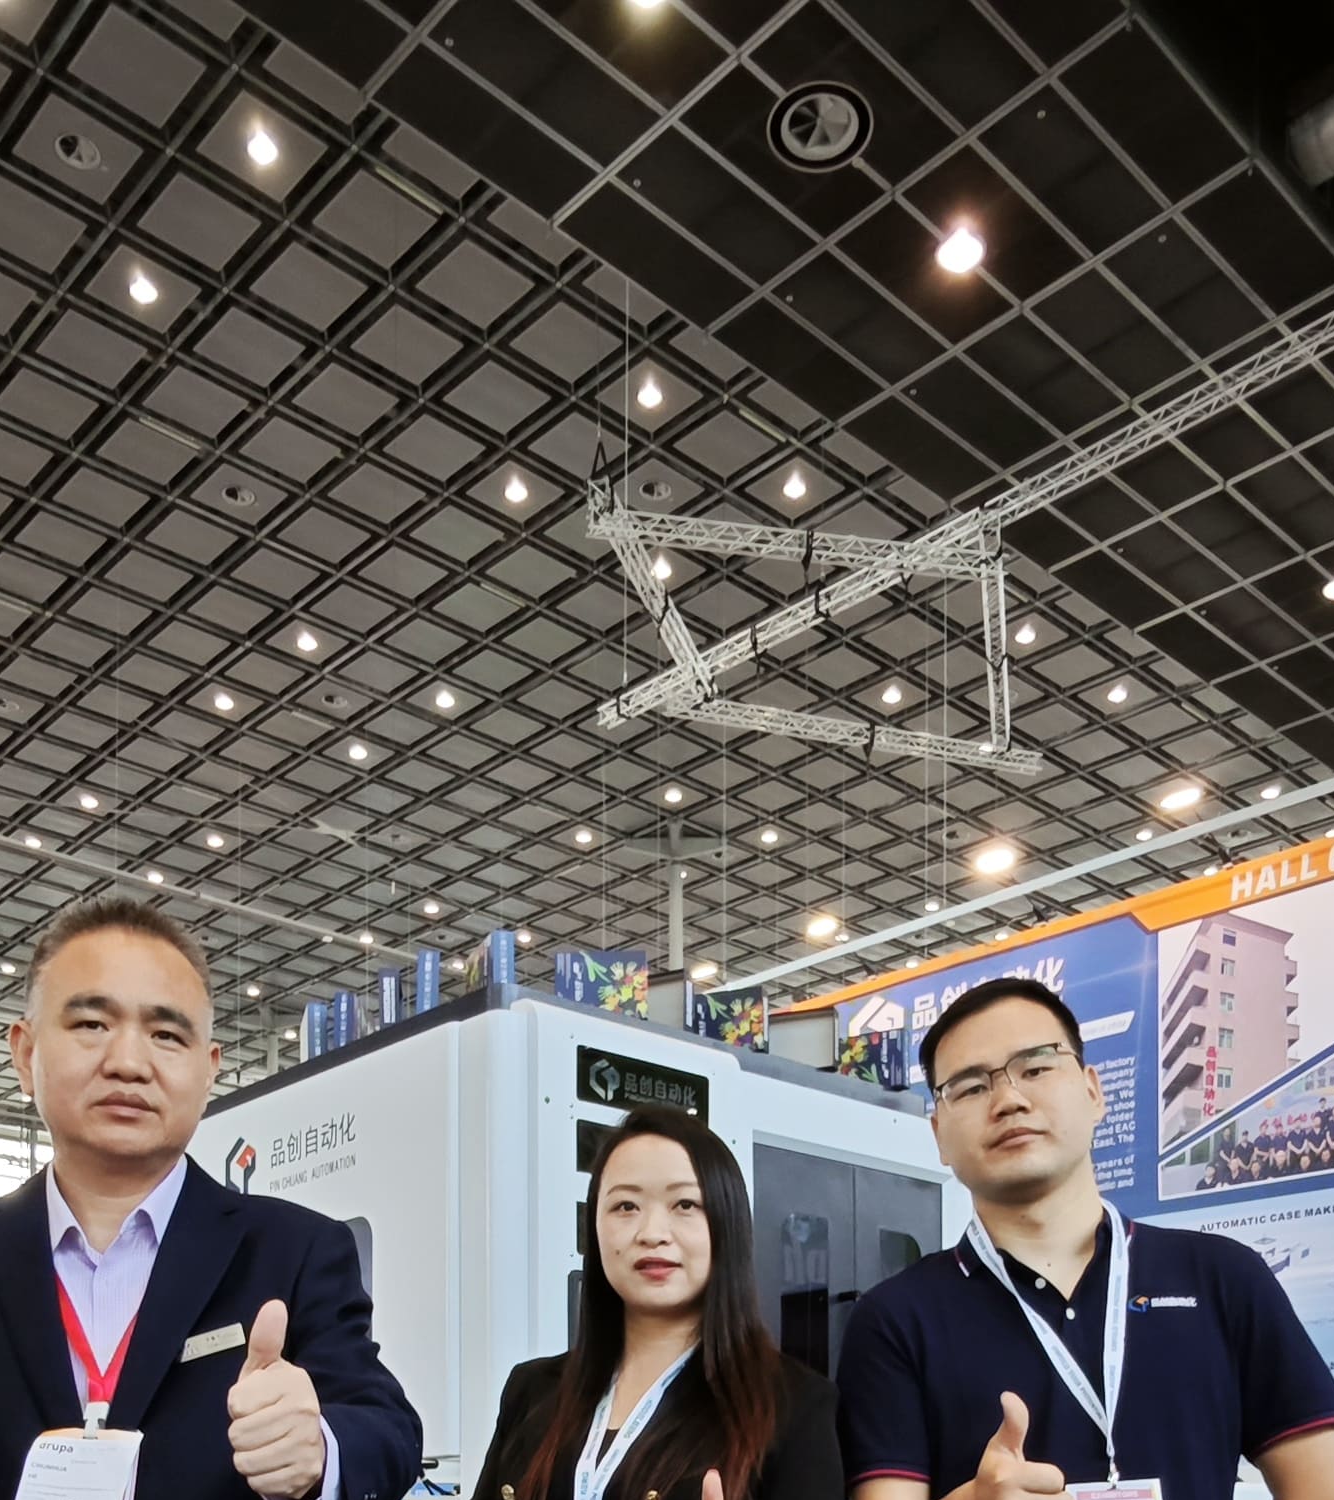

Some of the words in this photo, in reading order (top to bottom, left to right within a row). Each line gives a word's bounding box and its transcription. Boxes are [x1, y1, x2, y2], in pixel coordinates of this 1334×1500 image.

[1230, 853, 1317, 902] HALL
[269, 1111, 356, 1169] 品创自动化
[311, 1154, 356, 1180] AUTOMATION
[1199, 1214, 1267, 1233] AUTOMATIC
[1269, 1210, 1301, 1224] CASE
